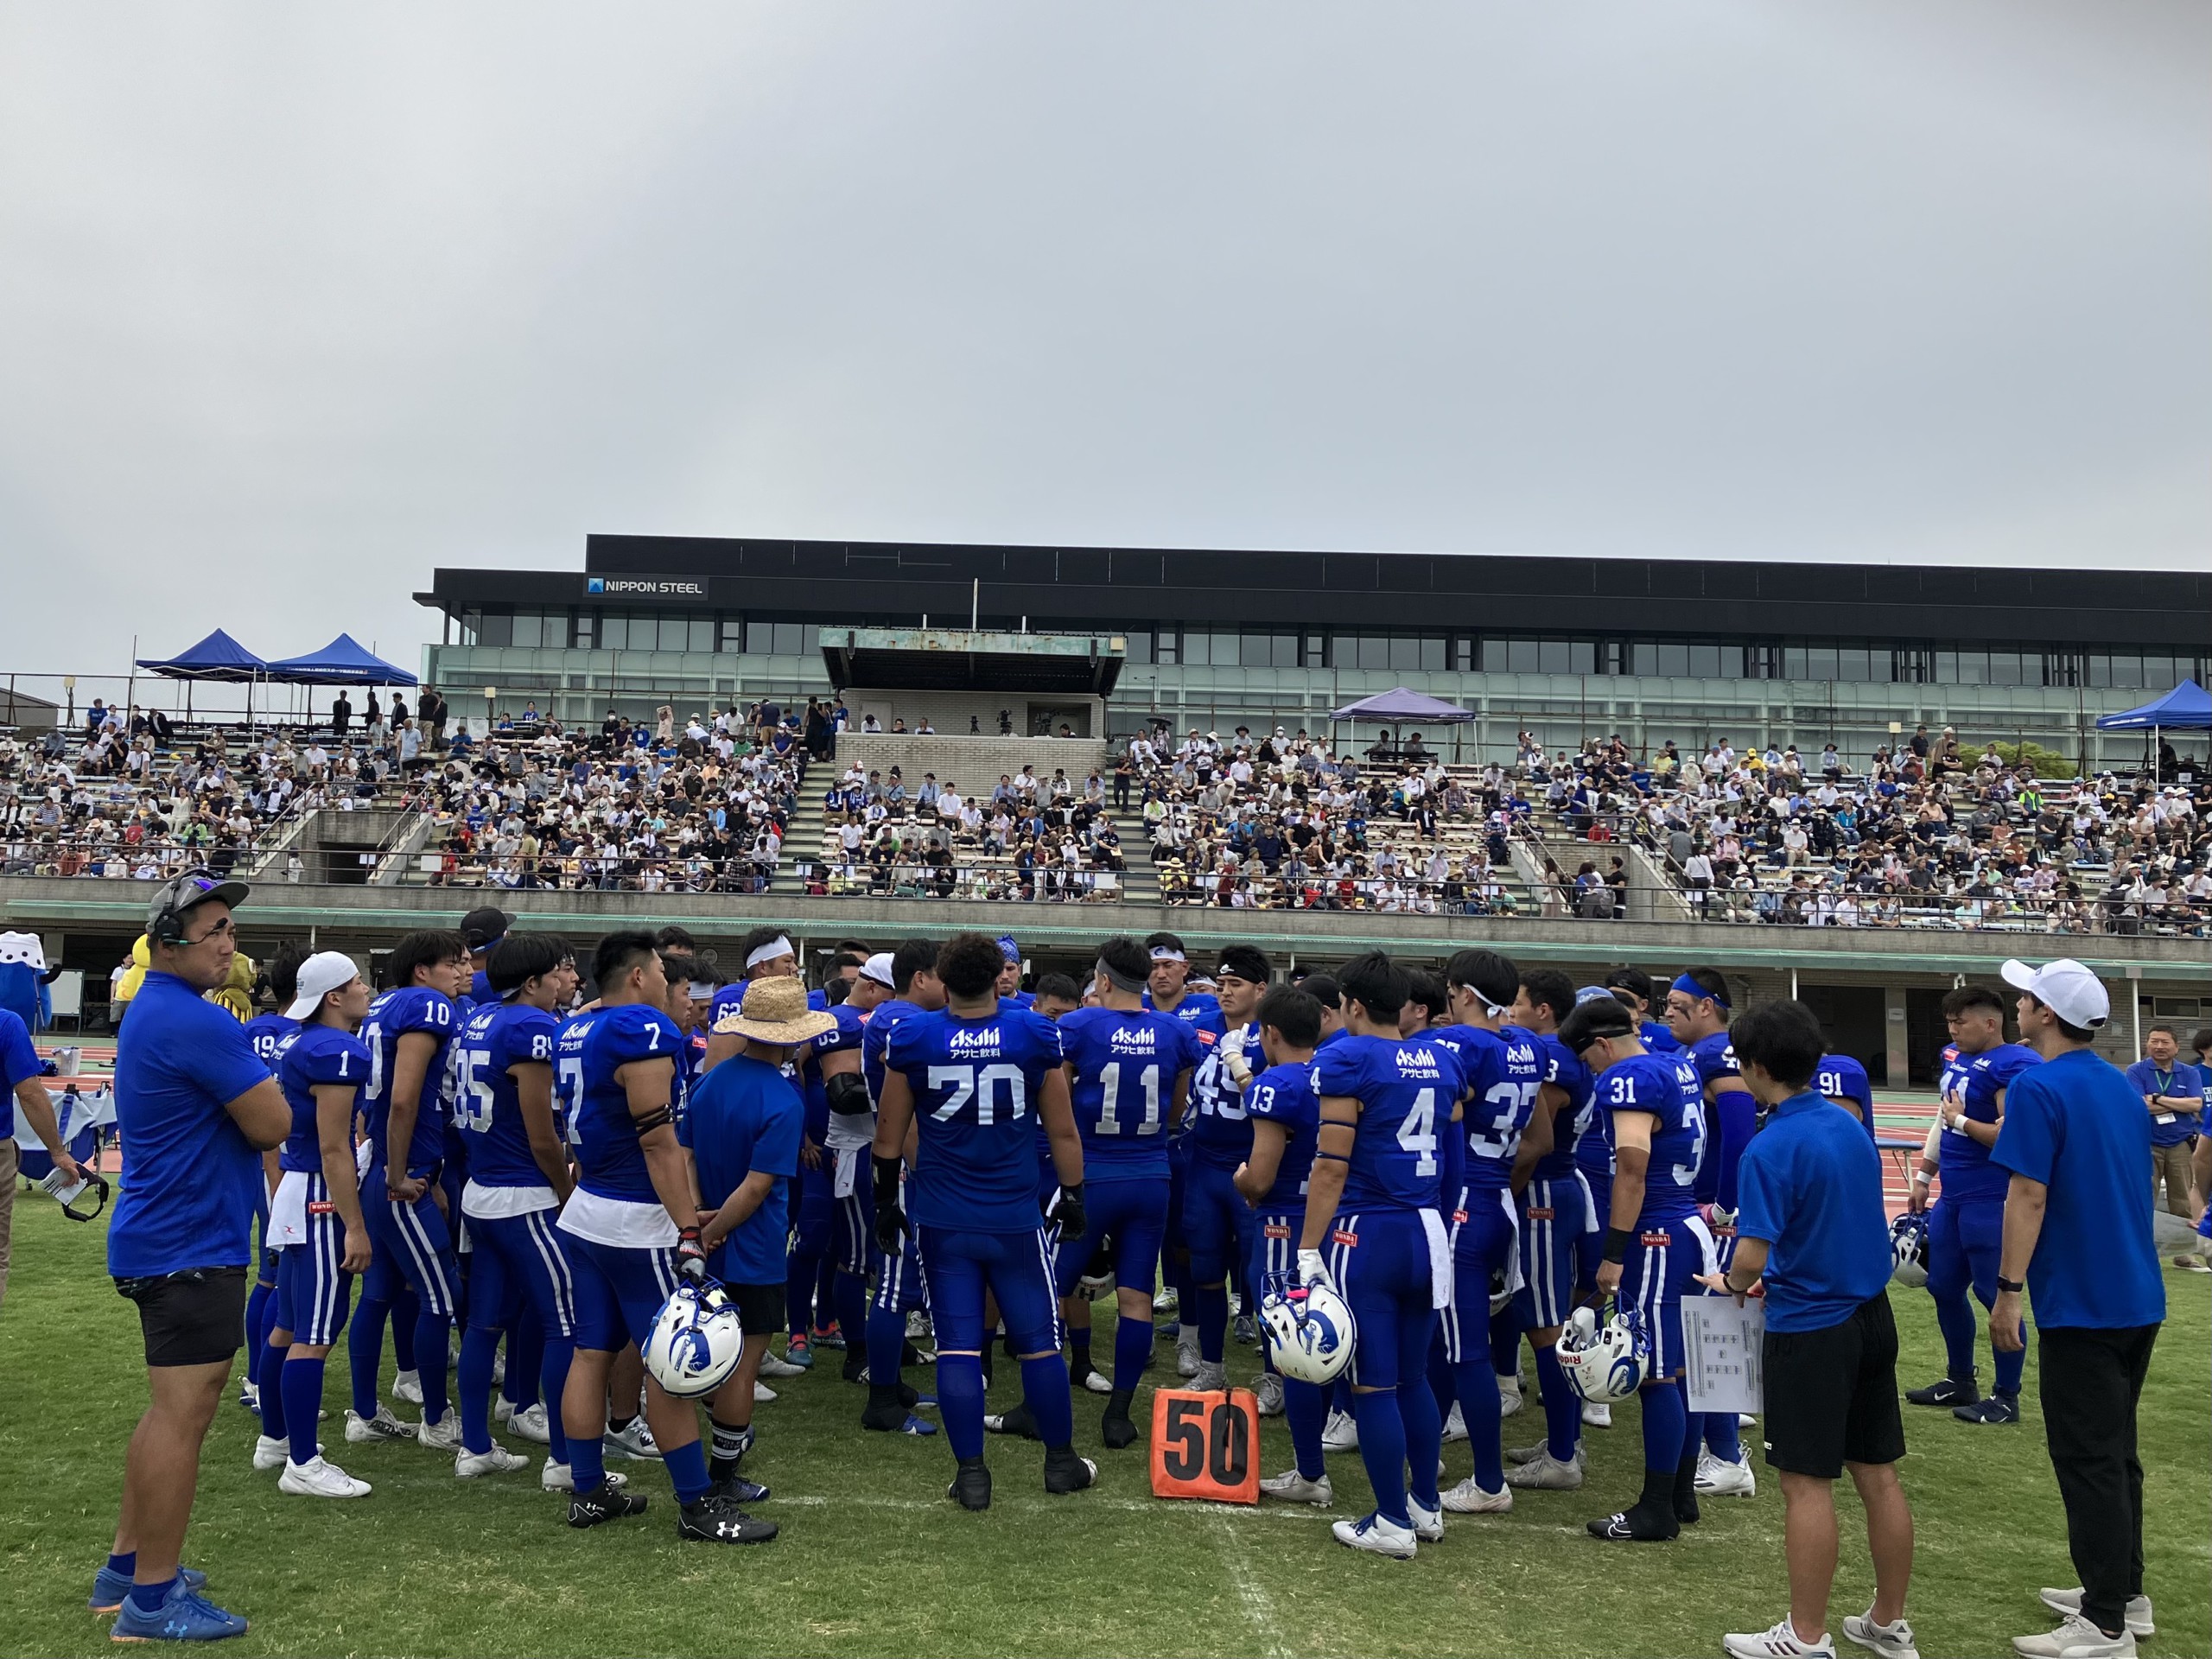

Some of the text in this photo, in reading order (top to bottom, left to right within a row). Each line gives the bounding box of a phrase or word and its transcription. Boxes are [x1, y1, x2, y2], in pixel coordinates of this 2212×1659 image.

[606, 581, 702, 594] NIPPON STEEL
[424, 1000, 449, 1026] 10
[253, 1035, 275, 1058] 19
[644, 1022, 661, 1050] 7
[950, 1027, 1000, 1047] Asahi
[1111, 1027, 1155, 1045] Asahi
[950, 1048, 1001, 1058] アサヒ飲料
[1111, 1045, 1155, 1055] アサヒ飲料
[1395, 1047, 1436, 1067] Asahi
[338, 1050, 349, 1077] 1
[1398, 1068, 1440, 1078] アサヒ飲料
[453, 1048, 494, 1133] 85
[1310, 1067, 1321, 1095] 4
[1611, 1077, 1636, 1103] 31
[1819, 1072, 1843, 1096] 91
[559, 1057, 584, 1145] 7
[927, 1064, 1025, 1125] 70
[1095, 1062, 1161, 1135] 11
[1250, 1084, 1275, 1113] 13
[1396, 1088, 1437, 1177] 4
[1469, 1082, 1542, 1159] 37
[1643, 1236, 1668, 1244] WONDA
[1164, 1398, 1249, 1485] 50
